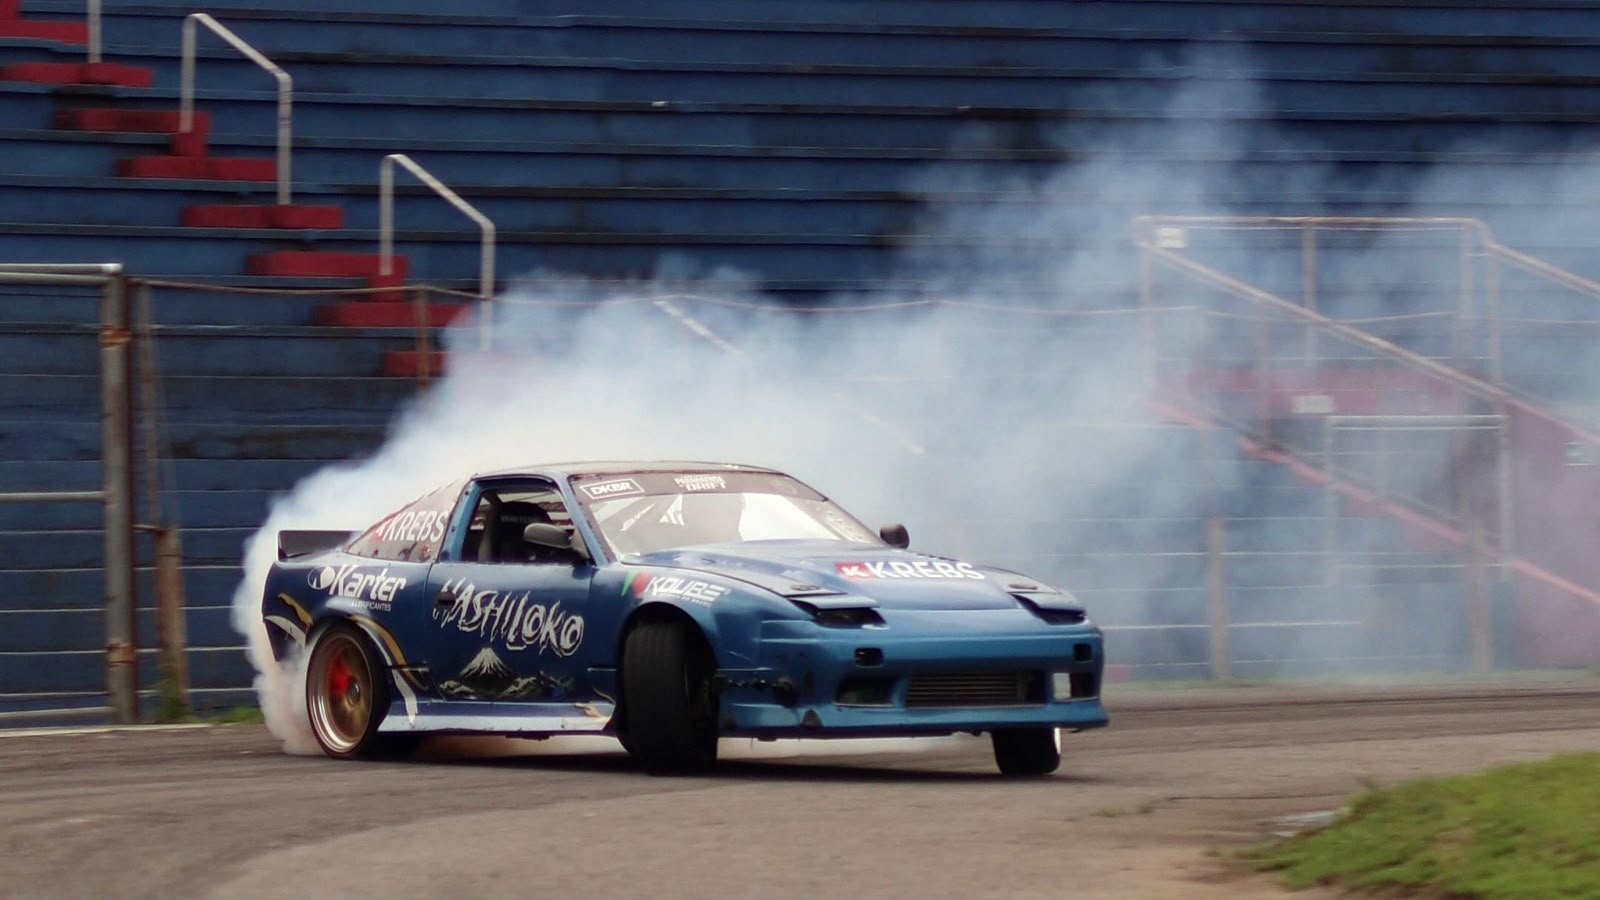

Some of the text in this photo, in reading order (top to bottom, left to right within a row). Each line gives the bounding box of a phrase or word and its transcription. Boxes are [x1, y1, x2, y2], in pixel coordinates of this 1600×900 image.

[590, 482, 633, 495] DKBR
[382, 511, 448, 542] KREBS
[328, 564, 407, 602] Karter
[865, 562, 985, 580] KREBS
[644, 576, 725, 602] KOUBE
